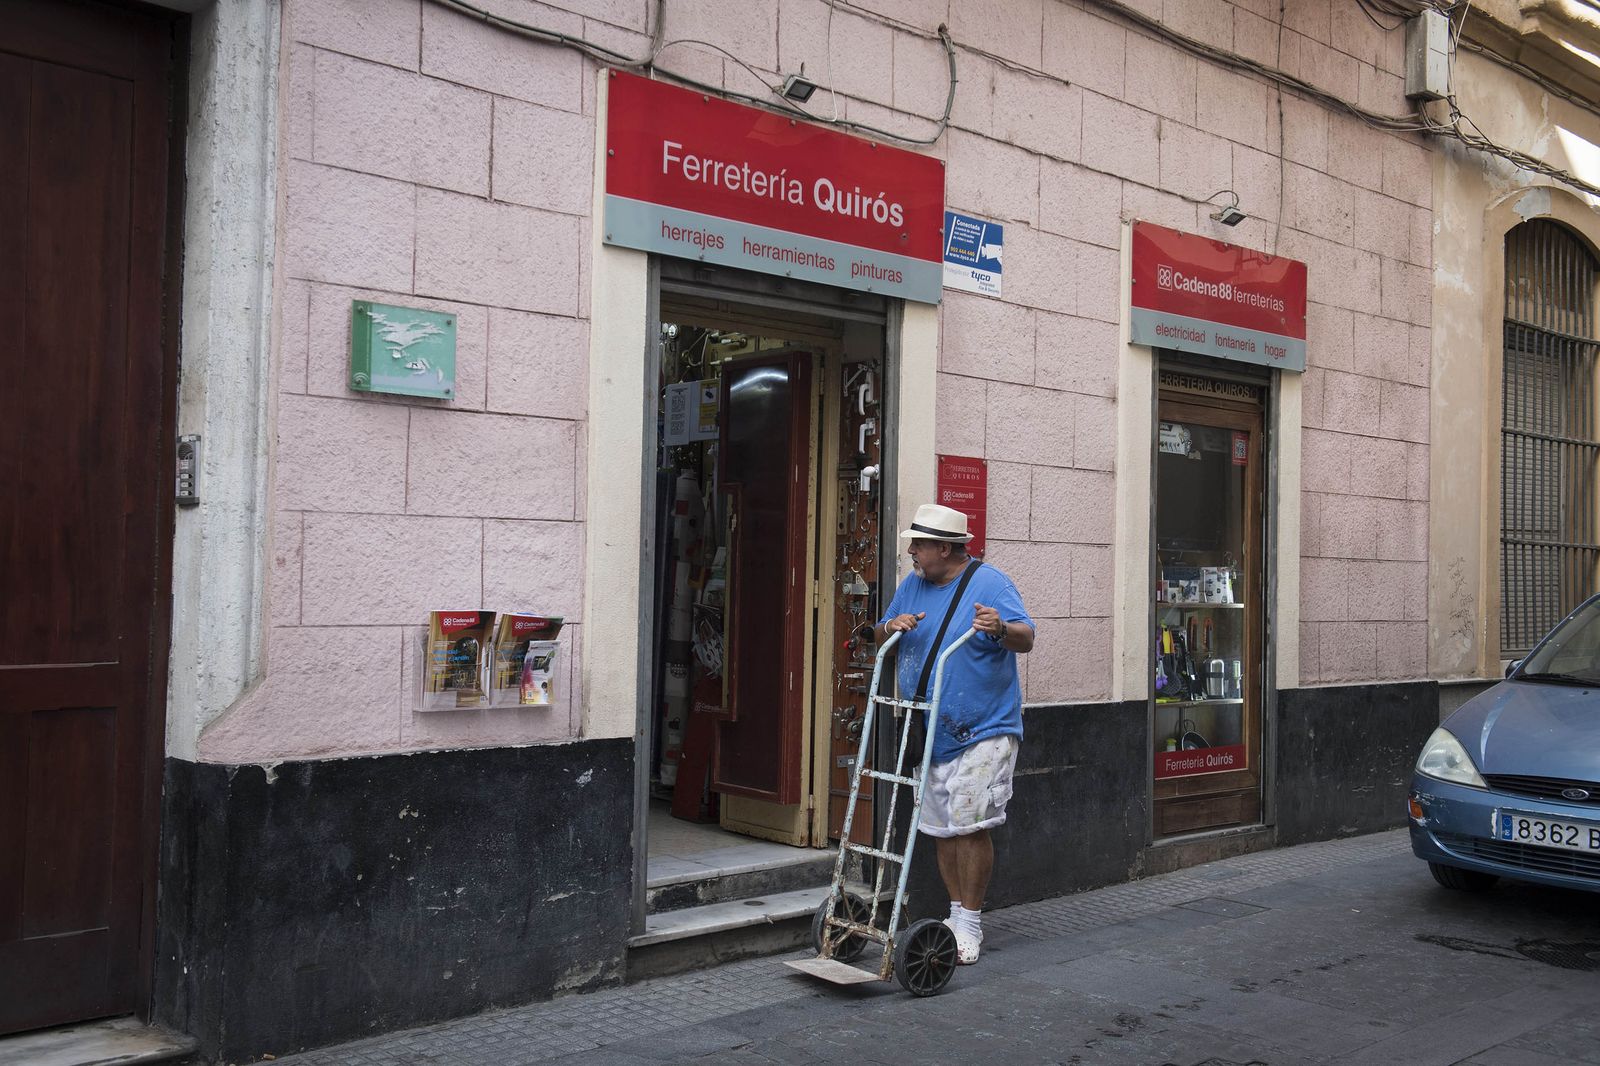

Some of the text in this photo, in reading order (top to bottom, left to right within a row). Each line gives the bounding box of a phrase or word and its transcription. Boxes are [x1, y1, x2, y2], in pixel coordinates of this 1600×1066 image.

[663, 140, 905, 227] Ferretería Quirós
[661, 220, 903, 284] herrajes herramientas pinturas
[971, 270, 991, 282] tyco
[1173, 271, 1232, 301] Cadena88
[1233, 286, 1285, 312] ferreterías
[1155, 322, 1287, 360] electricidad fontanería hogar
[1160, 373, 1250, 398] ERRETERIA QUIROS
[1206, 752, 1234, 767] Quirós
[1518, 819, 1579, 847] 8362
